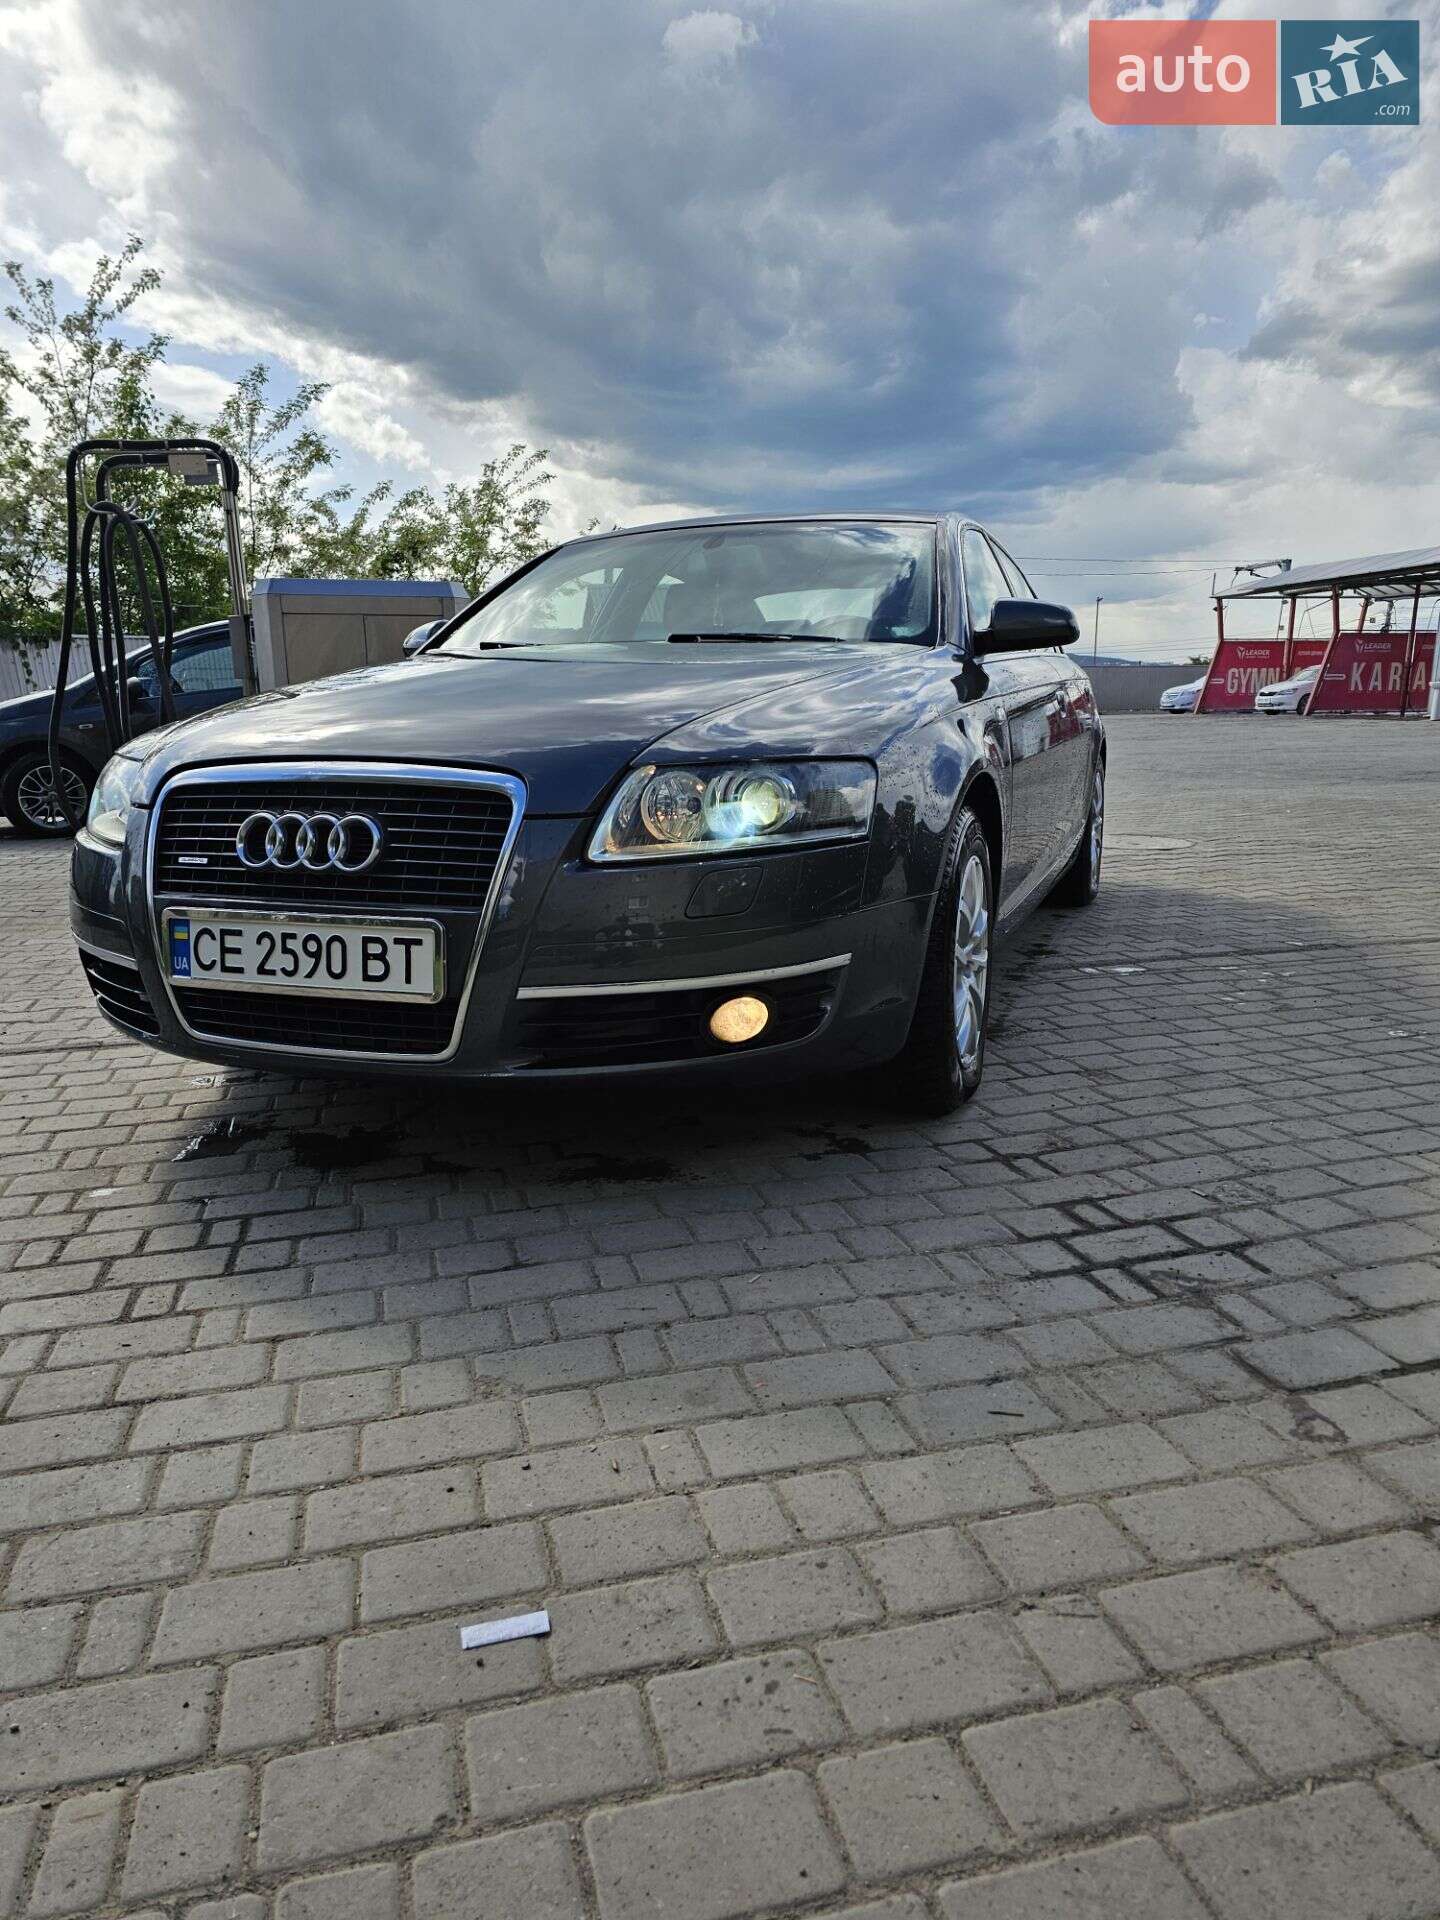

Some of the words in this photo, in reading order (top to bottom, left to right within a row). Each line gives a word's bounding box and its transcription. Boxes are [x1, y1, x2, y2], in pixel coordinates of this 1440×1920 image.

[1227, 667, 1301, 694] GYMN
[174, 955, 190, 971] UA
[193, 927, 245, 974] CE
[255, 931, 348, 980] 2590
[361, 935, 423, 985] BT
